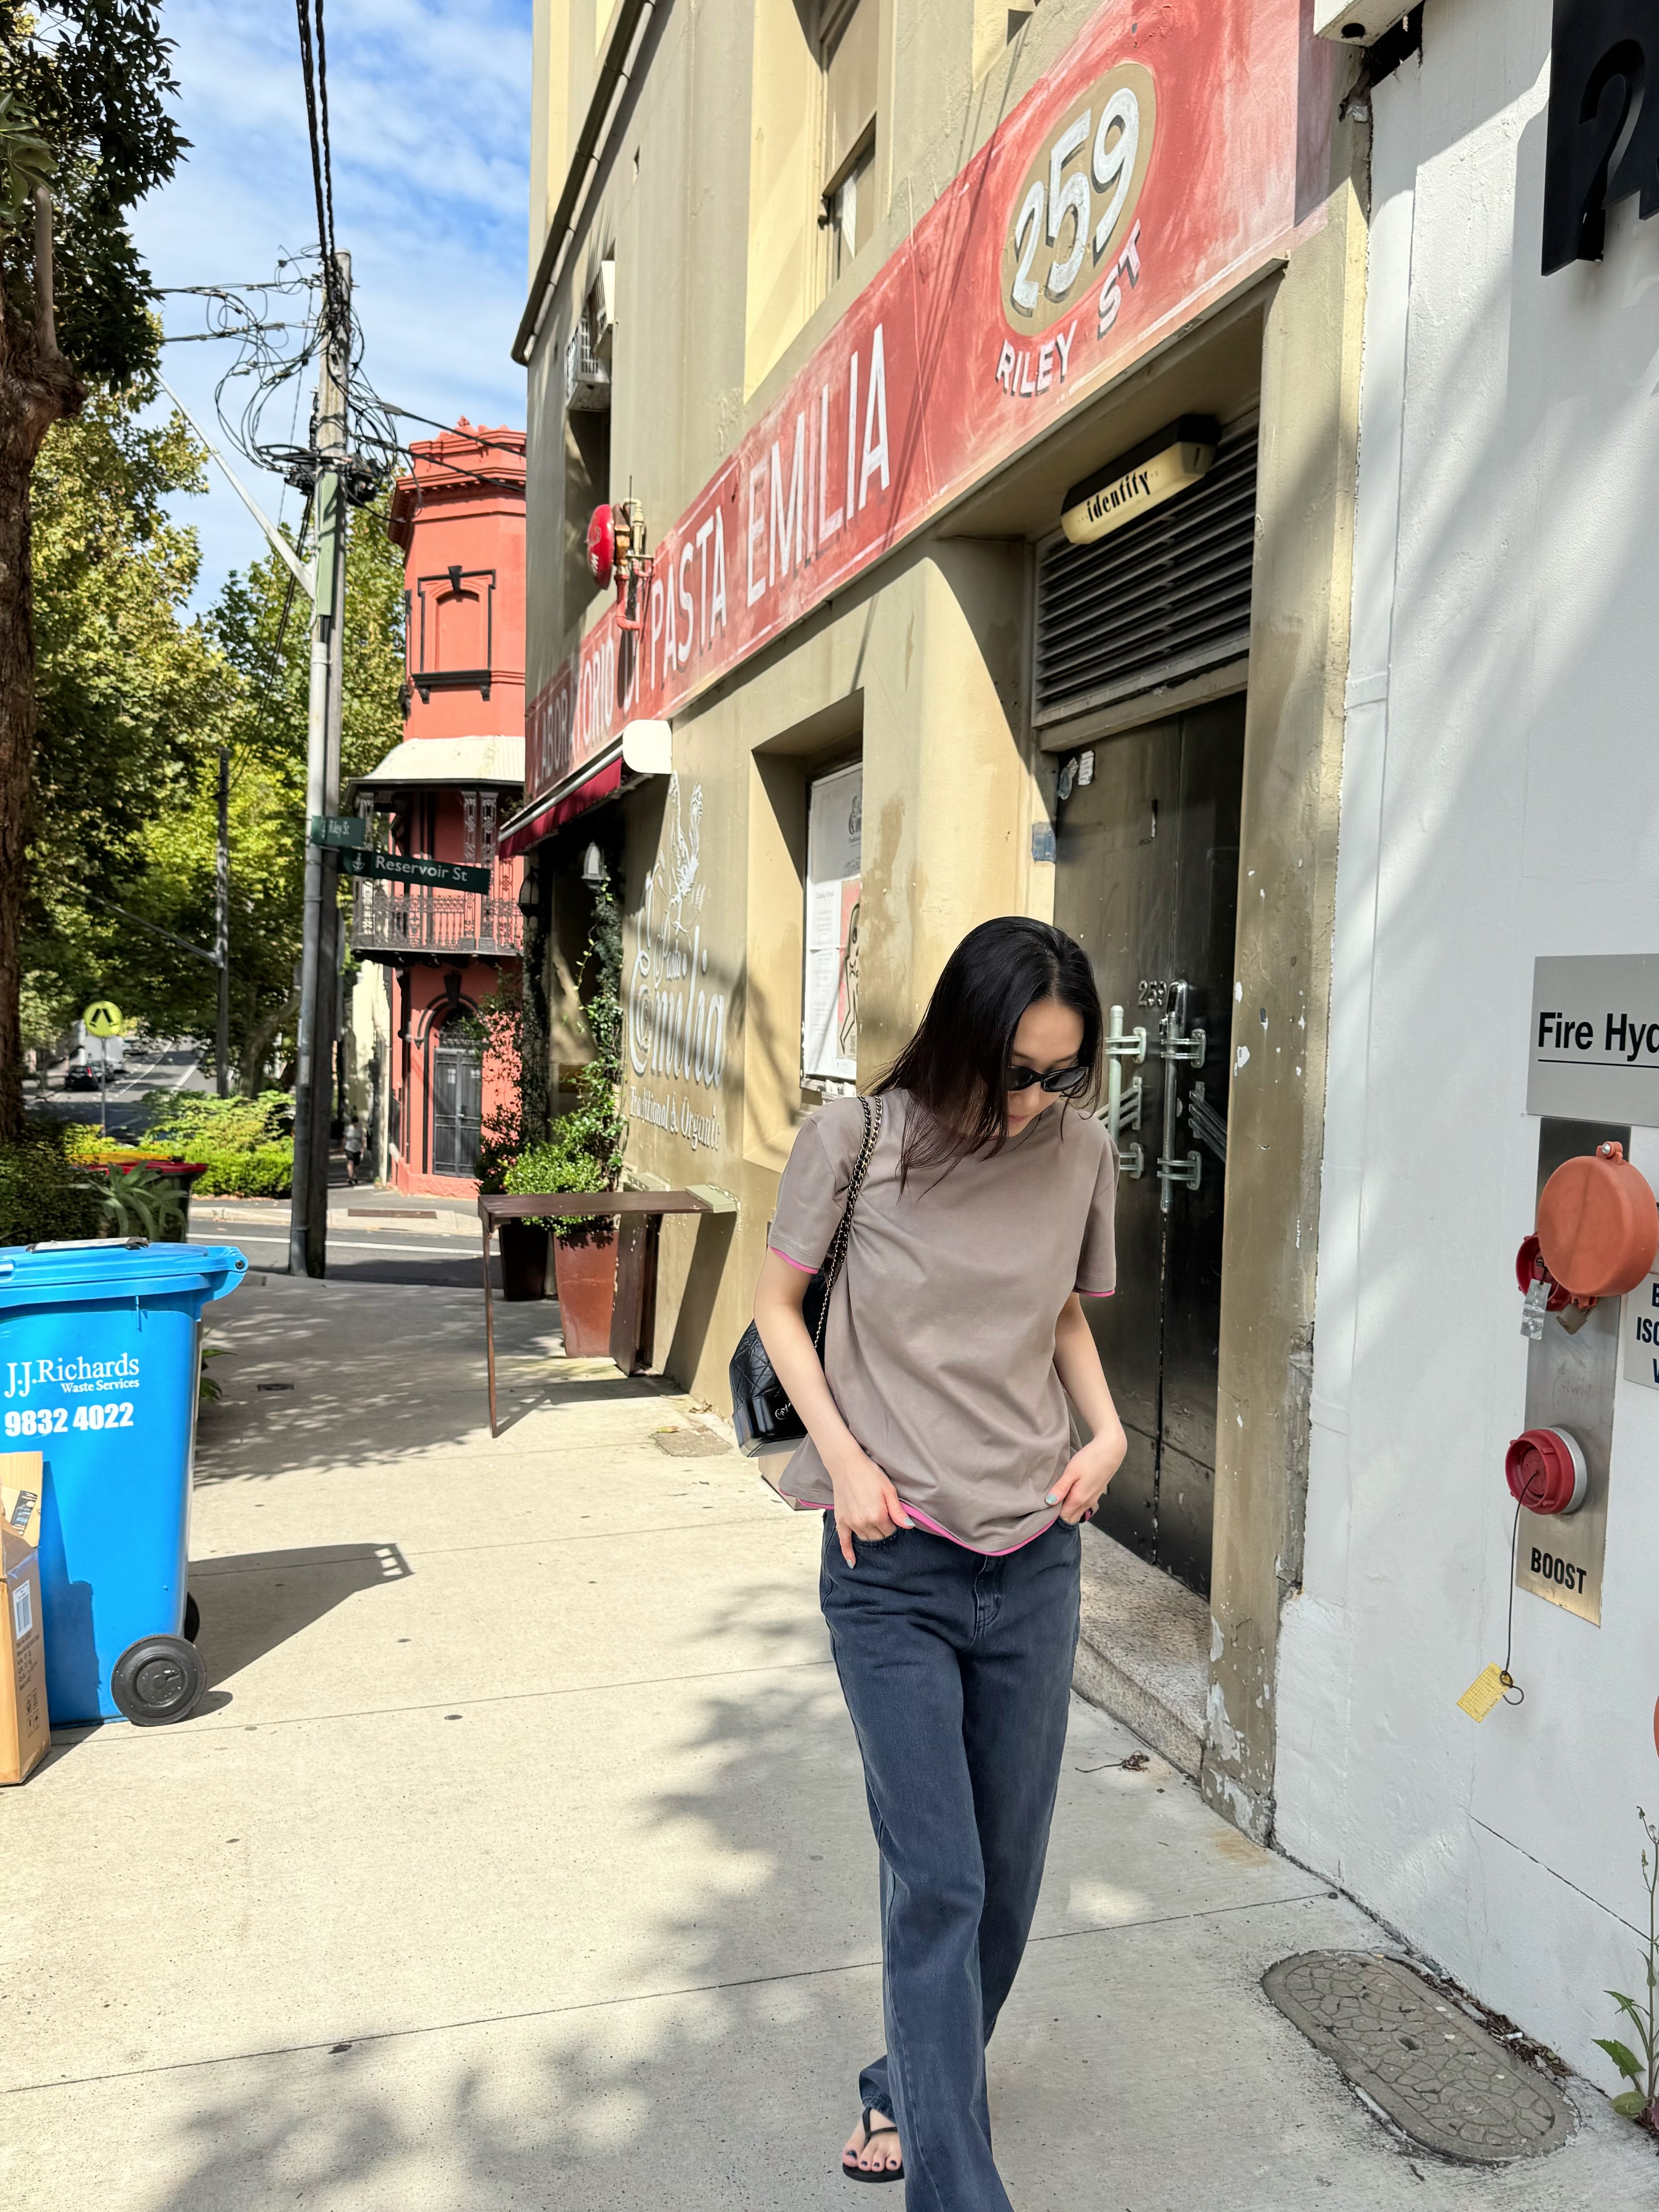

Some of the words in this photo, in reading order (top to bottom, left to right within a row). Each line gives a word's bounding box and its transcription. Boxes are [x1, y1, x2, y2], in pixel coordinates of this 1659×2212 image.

[1012, 87, 1139, 309] 259
[997, 320, 1077, 394] RILEY
[1099, 218, 1141, 338] ST
[650, 505, 727, 691] PASTA
[747, 323, 890, 608] EMILIA
[1087, 471, 1150, 522] identity
[375, 855, 449, 879] Reservoir
[452, 869, 468, 882] St
[1538, 1012, 1593, 1050] Fire
[629, 1086, 670, 1131] Traditional
[670, 1091, 679, 1134] &
[681, 1096, 720, 1150] Organic
[60, 1382, 94, 1393] Waste
[96, 1379, 140, 1392] Services
[4, 1408, 68, 1437] 9832
[73, 1402, 134, 1431] 4022
[1530, 1546, 1587, 1595] BOOST
